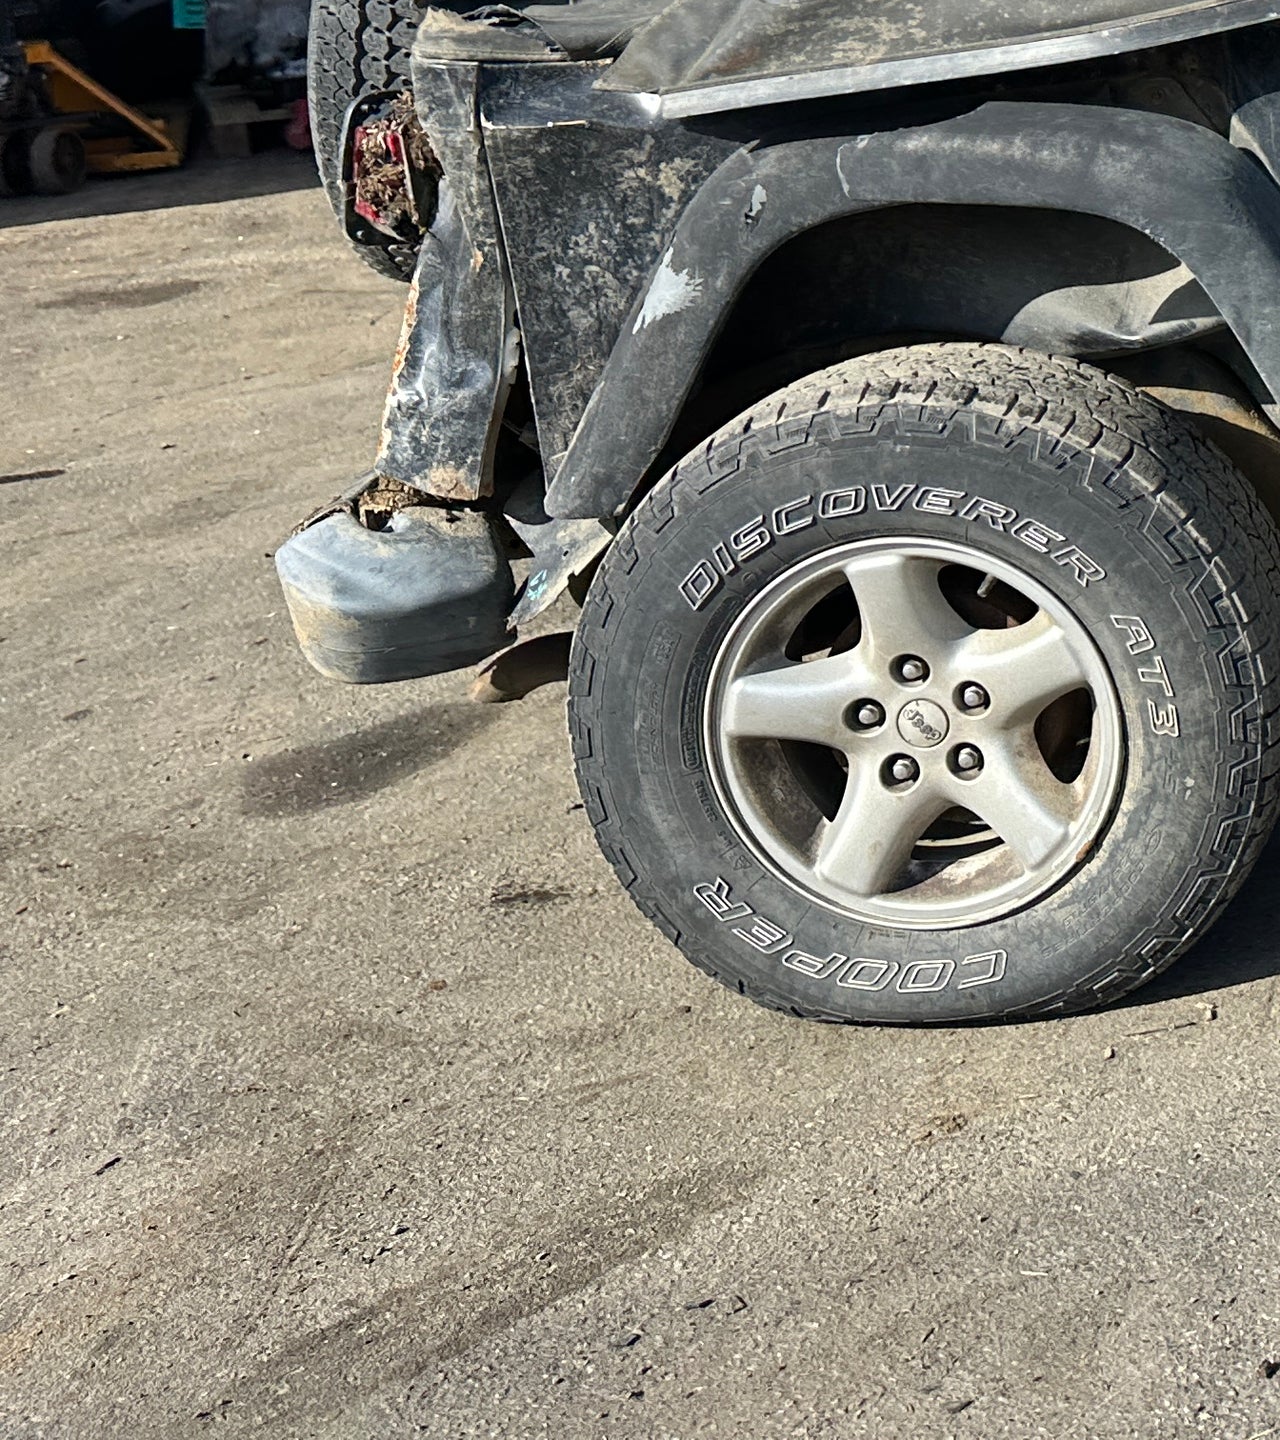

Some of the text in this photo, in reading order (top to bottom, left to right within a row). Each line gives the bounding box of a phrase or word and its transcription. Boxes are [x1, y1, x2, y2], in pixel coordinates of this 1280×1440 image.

[677, 482, 1180, 738] DISCOVERER AT3
[694, 876, 1007, 994] COOPER
